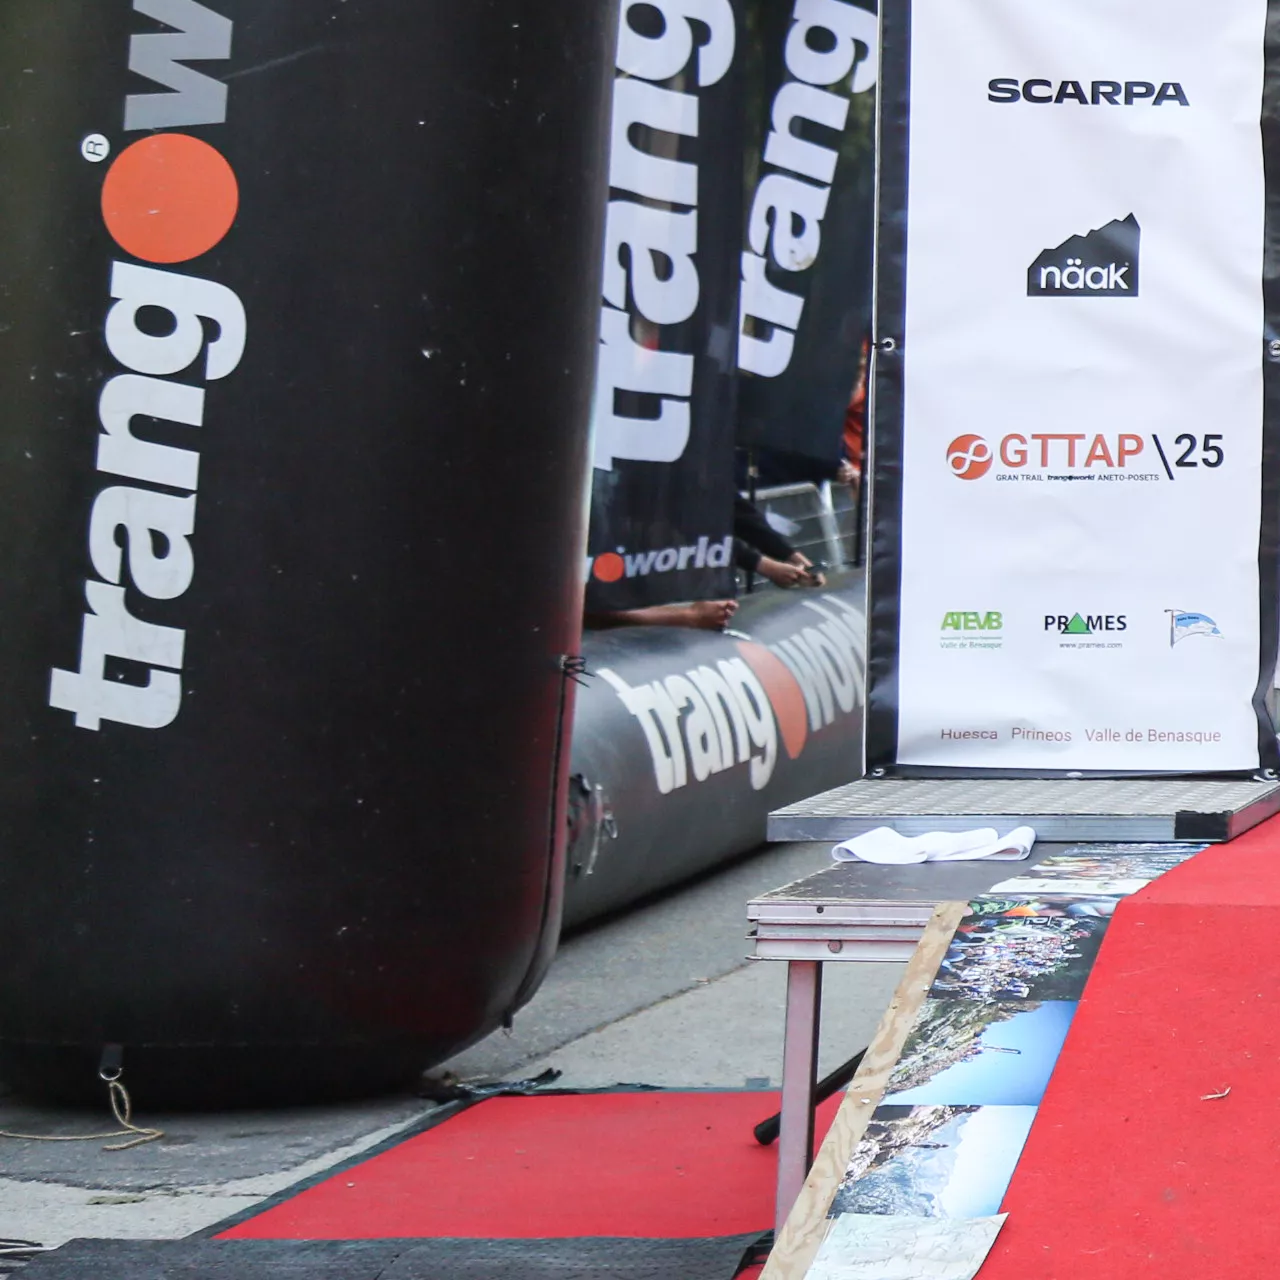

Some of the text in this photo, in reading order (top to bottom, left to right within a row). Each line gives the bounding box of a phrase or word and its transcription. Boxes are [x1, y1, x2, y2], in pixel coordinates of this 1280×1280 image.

[987, 78, 1190, 107] SCARPA
[1041, 258, 1129, 291] näak
[1000, 433, 1144, 468] GTTAP
[969, 641, 1002, 651] Benasque
[1060, 641, 1123, 650] www.prames.com
[941, 727, 1222, 746] Huesca Pirineos Valle de Benasque
